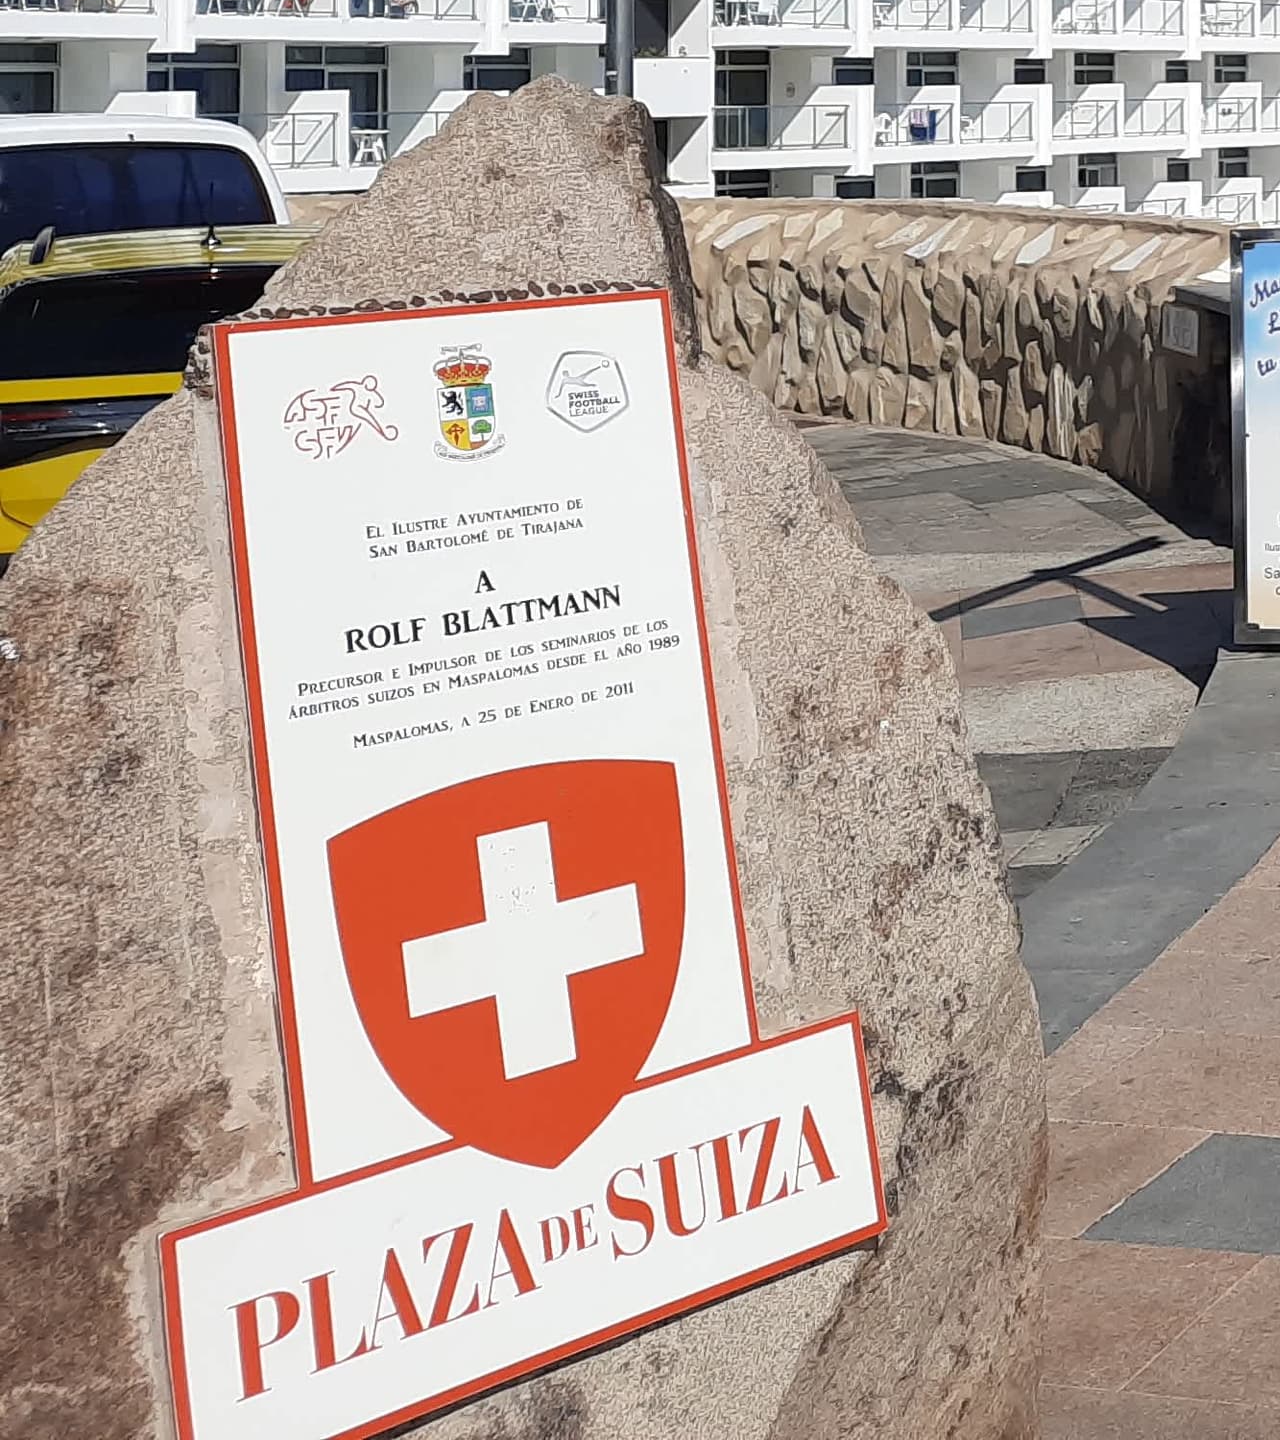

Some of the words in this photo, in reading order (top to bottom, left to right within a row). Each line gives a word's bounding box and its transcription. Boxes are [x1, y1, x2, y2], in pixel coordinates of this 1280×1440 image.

[1257, 359, 1277, 376] tu
[568, 390, 599, 401] SWISS
[568, 396, 621, 408] FOOTBALL
[569, 405, 609, 417] LEAGUE
[474, 569, 497, 594] A
[344, 617, 427, 654] ROLF
[441, 584, 621, 637] BLATTMANN
[648, 634, 681, 651] 1989
[478, 709, 497, 724] 25
[605, 681, 634, 699] 2011
[226, 1207, 545, 1402] PLAZA
[538, 1203, 600, 1264] DE
[604, 1104, 841, 1261] SUIZA
